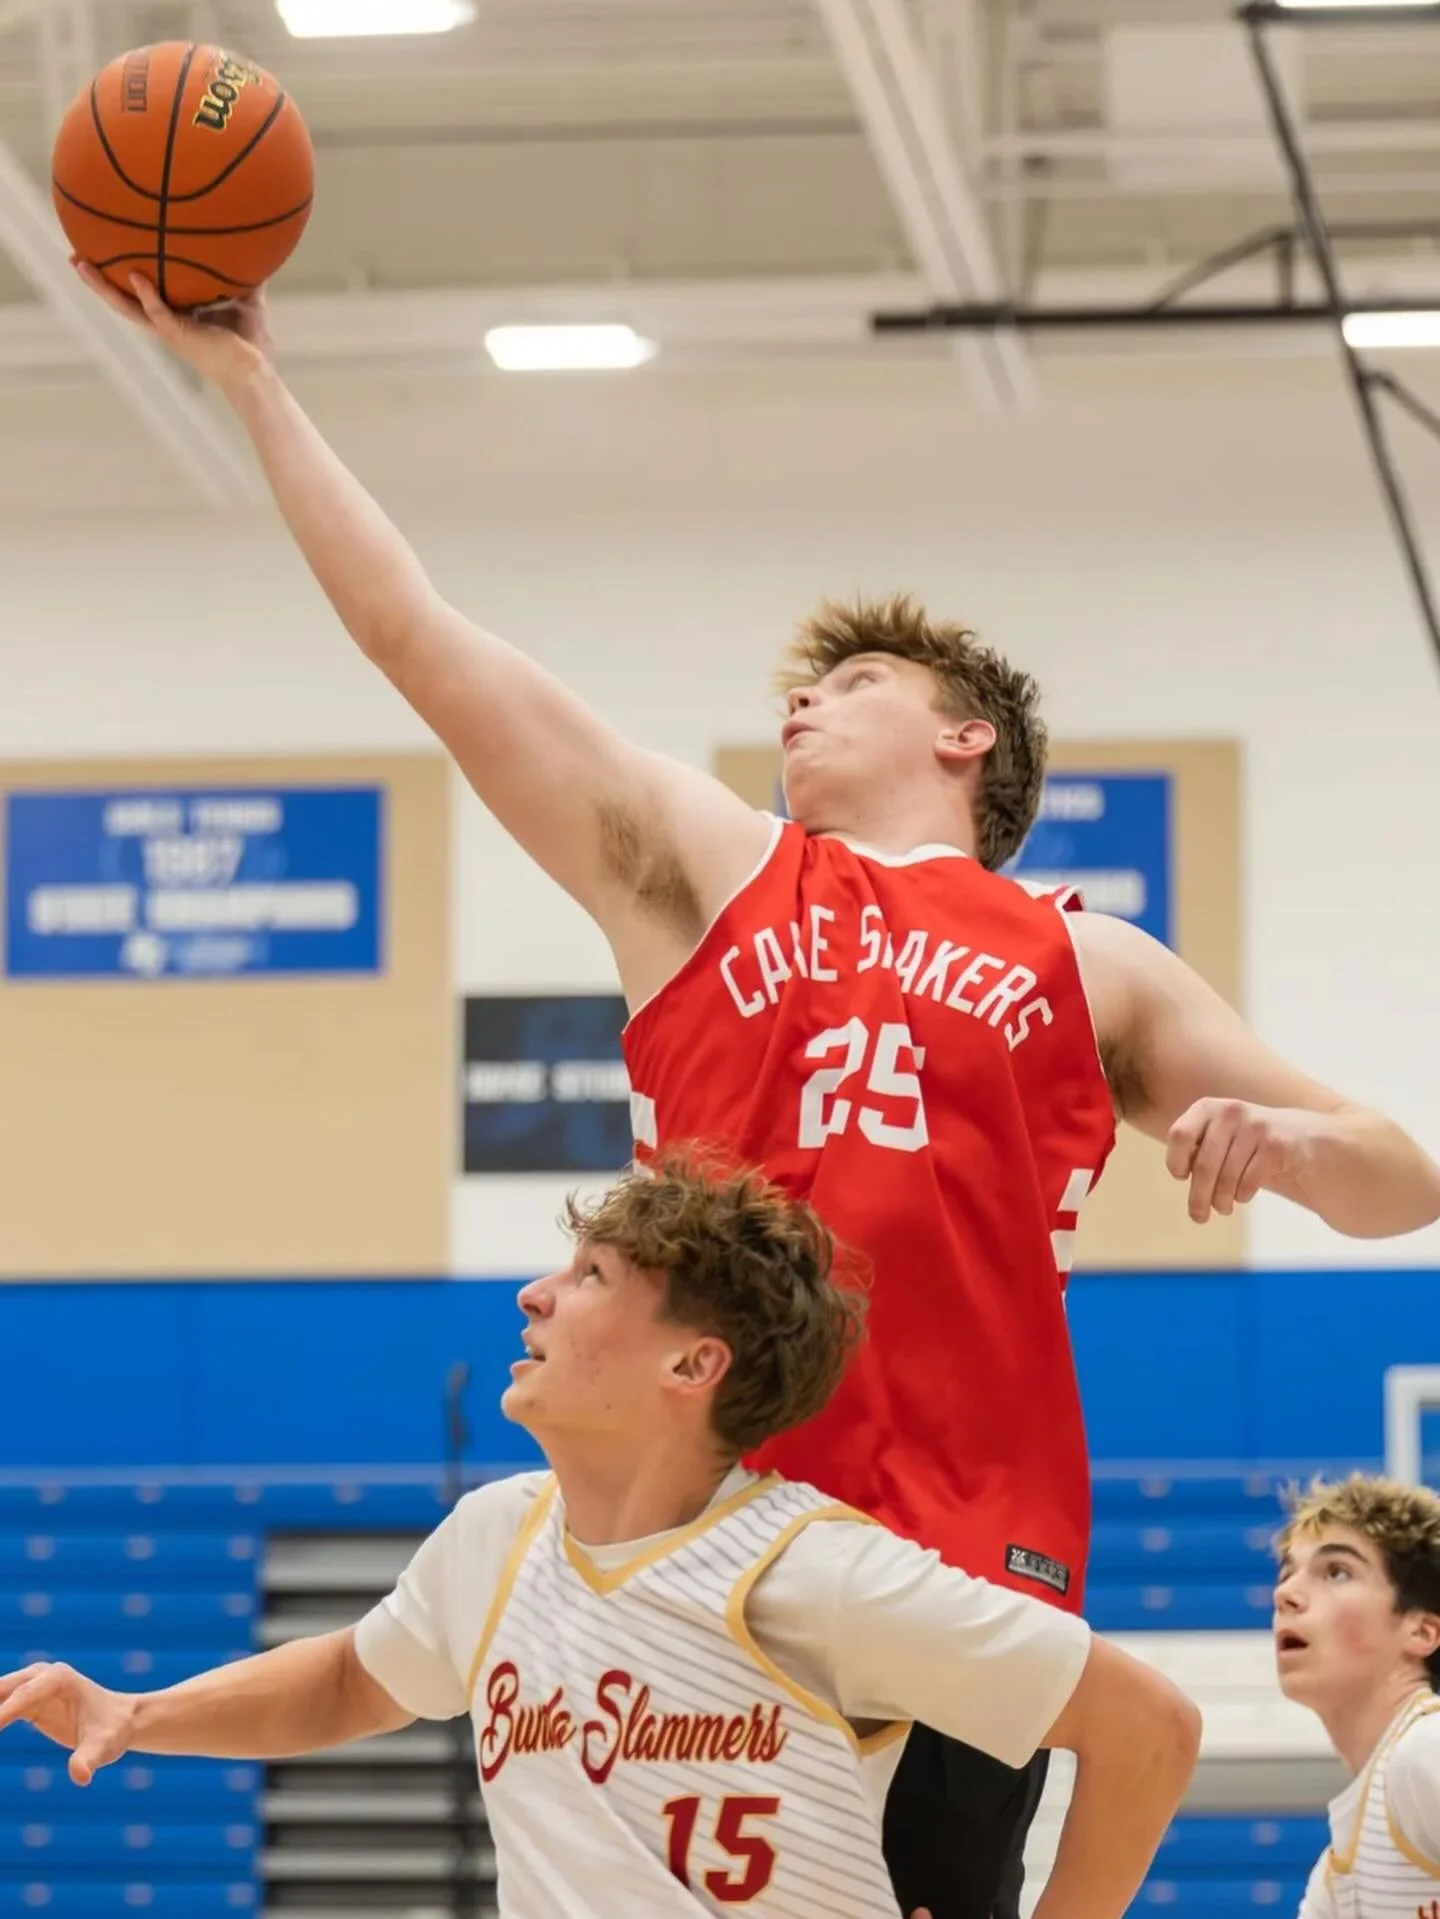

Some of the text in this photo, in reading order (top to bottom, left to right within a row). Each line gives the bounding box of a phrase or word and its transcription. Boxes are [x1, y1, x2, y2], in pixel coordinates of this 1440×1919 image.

[799, 1016, 929, 1152] 25
[581, 1669, 788, 1784] Slammers
[661, 1794, 781, 1903] 15
